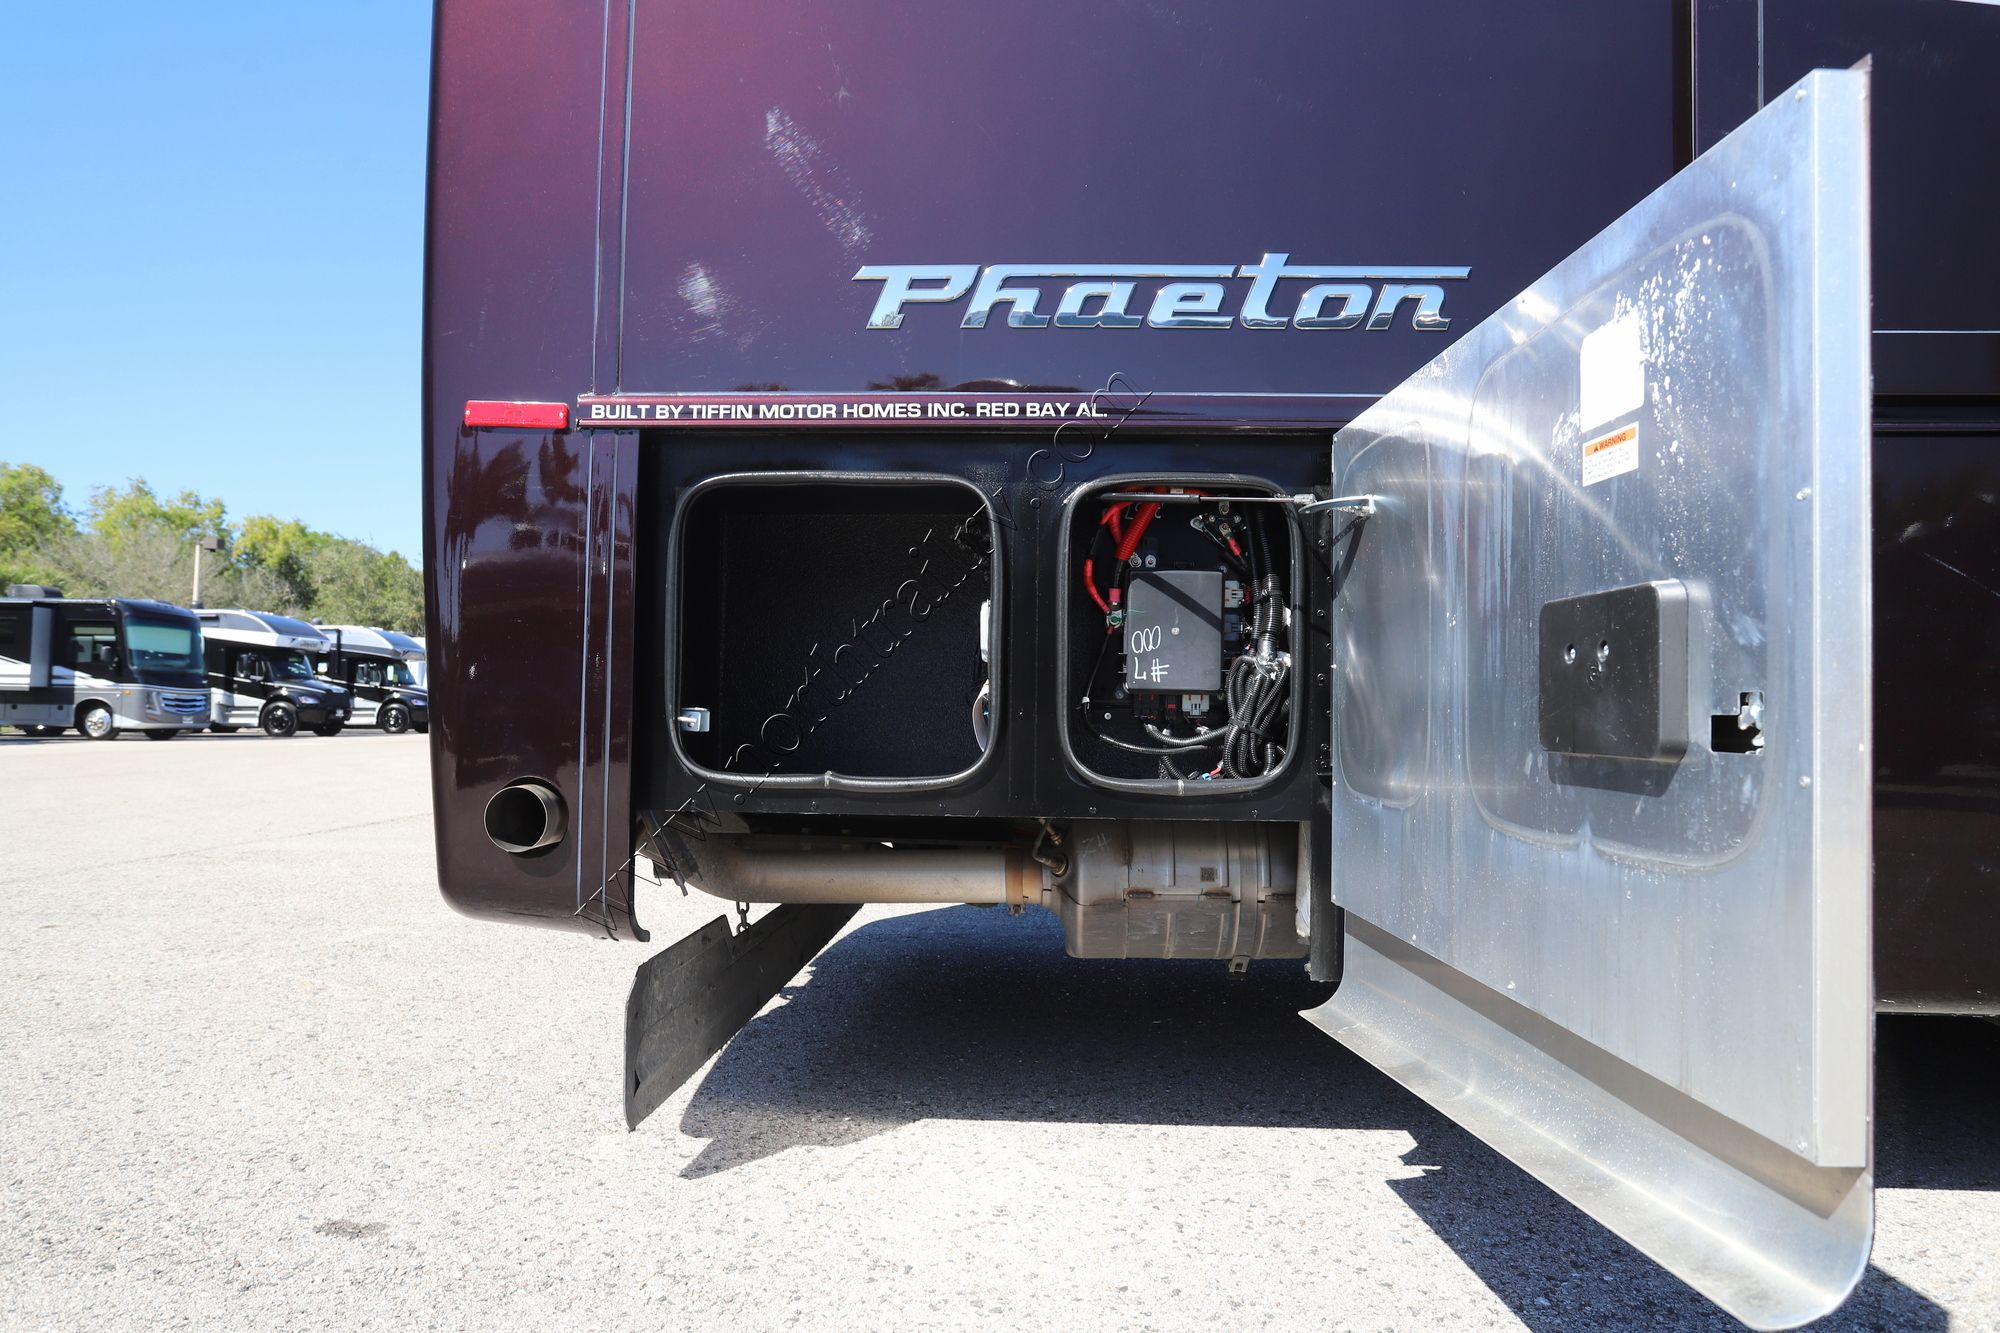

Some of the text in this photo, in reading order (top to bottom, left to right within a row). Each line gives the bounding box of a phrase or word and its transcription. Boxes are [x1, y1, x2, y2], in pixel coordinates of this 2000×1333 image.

[852, 252, 1472, 330] Phaeton
[591, 402, 1108, 419] BUILT BY TIFFIN MOTOR HOMES INC. RED BAY AL.
[1598, 432, 1627, 451] WARNING
